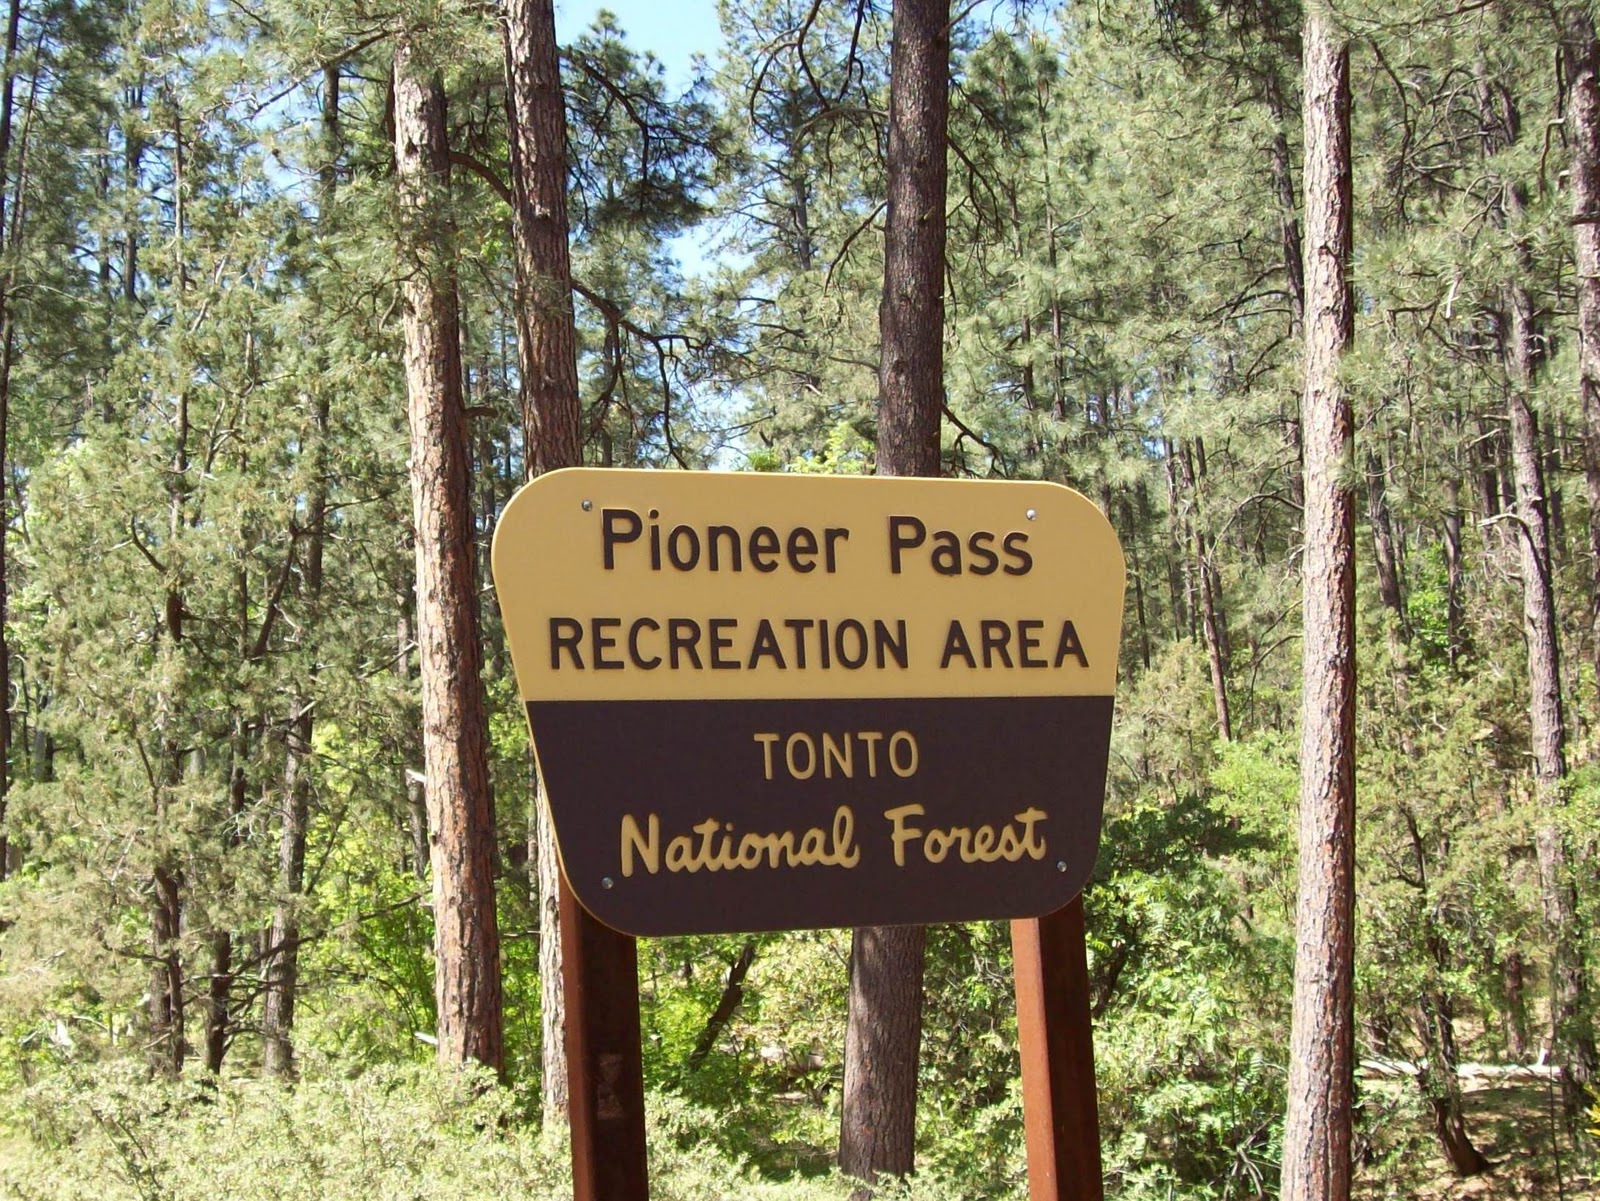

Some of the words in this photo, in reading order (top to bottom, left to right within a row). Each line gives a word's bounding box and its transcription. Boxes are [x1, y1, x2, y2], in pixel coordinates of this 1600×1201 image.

[601, 509, 850, 574] Pioneer
[887, 516, 1034, 577] Pass
[549, 617, 909, 672] RECREATION
[939, 620, 1090, 670] AREA
[753, 731, 920, 780] TONTO
[621, 805, 860, 877] National
[884, 803, 1048, 867] Forest
